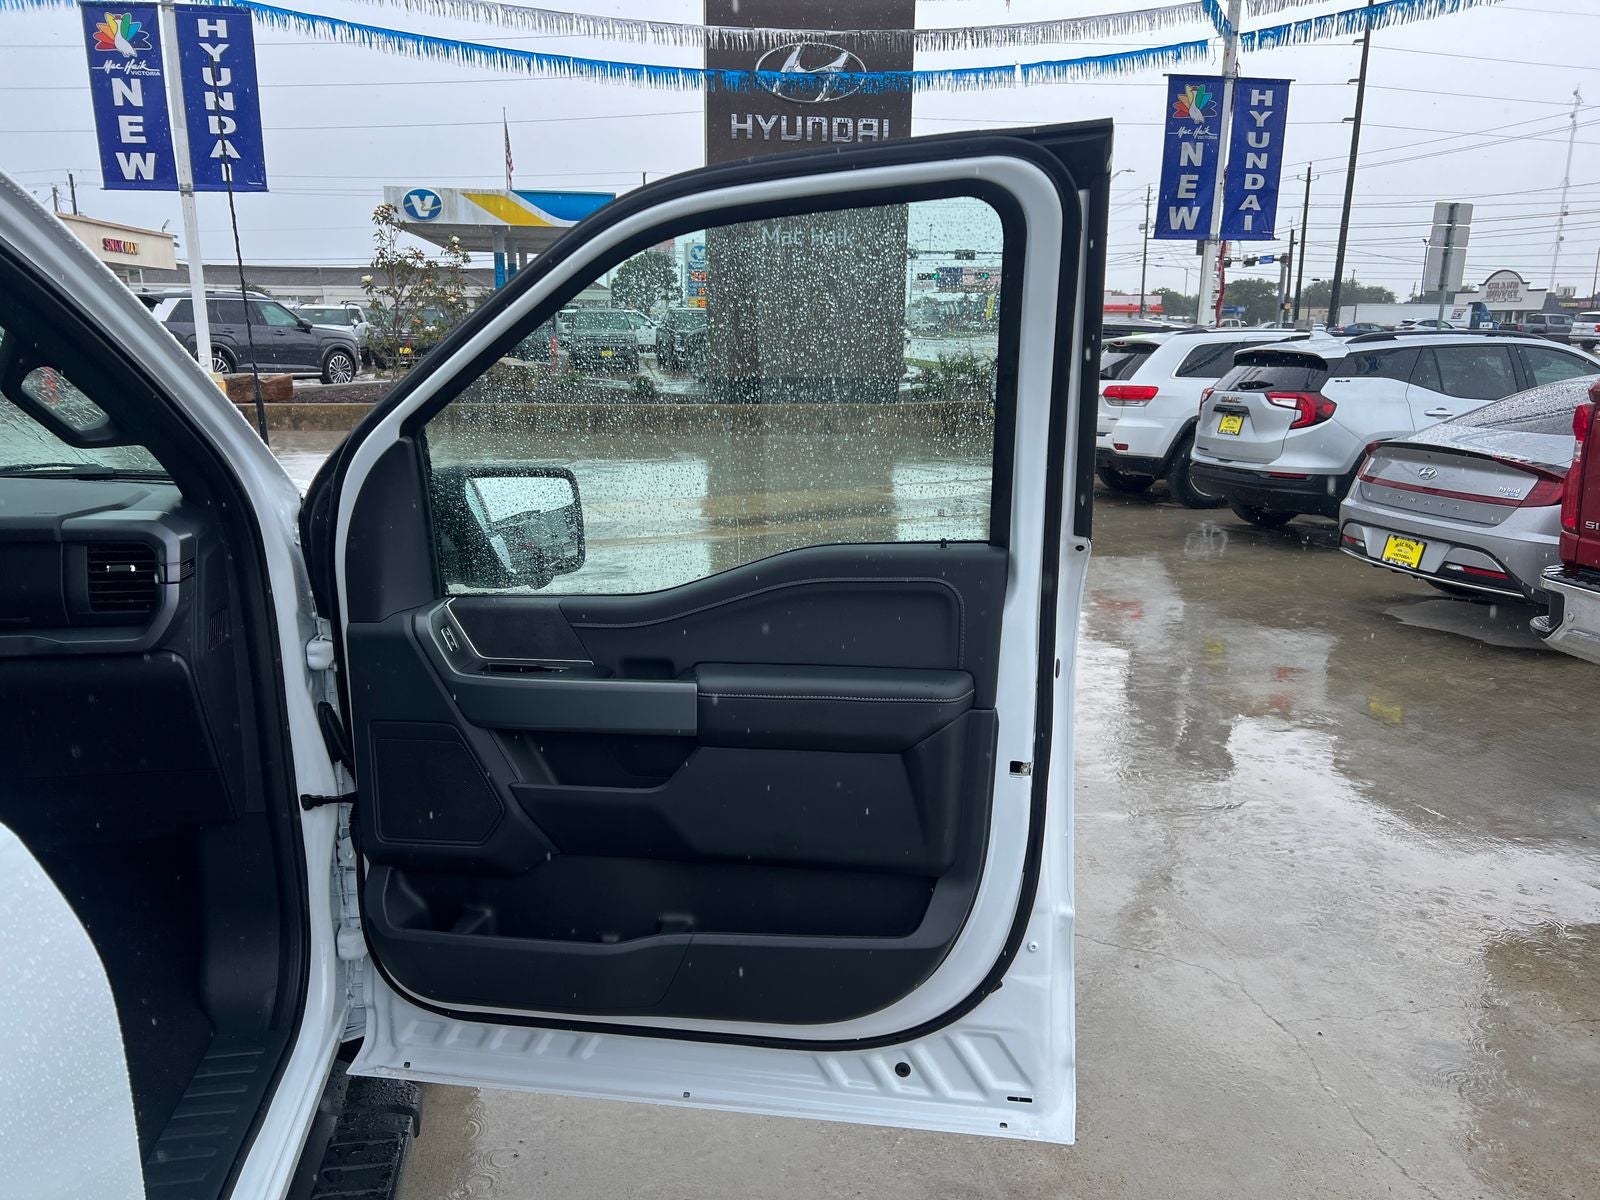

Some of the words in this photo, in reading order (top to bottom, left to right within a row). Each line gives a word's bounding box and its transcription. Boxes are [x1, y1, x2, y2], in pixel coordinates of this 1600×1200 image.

[98, 59, 123, 74] Mac
[124, 58, 151, 75] Haik
[197, 19, 241, 182] HYUNDAI
[111, 78, 156, 181] NEW
[730, 113, 890, 143] HYUNDAI
[1238, 89, 1274, 231] HYUNDAI
[1168, 142, 1204, 231] NEW
[762, 225, 802, 246] Mac
[811, 227, 854, 246] Haik
